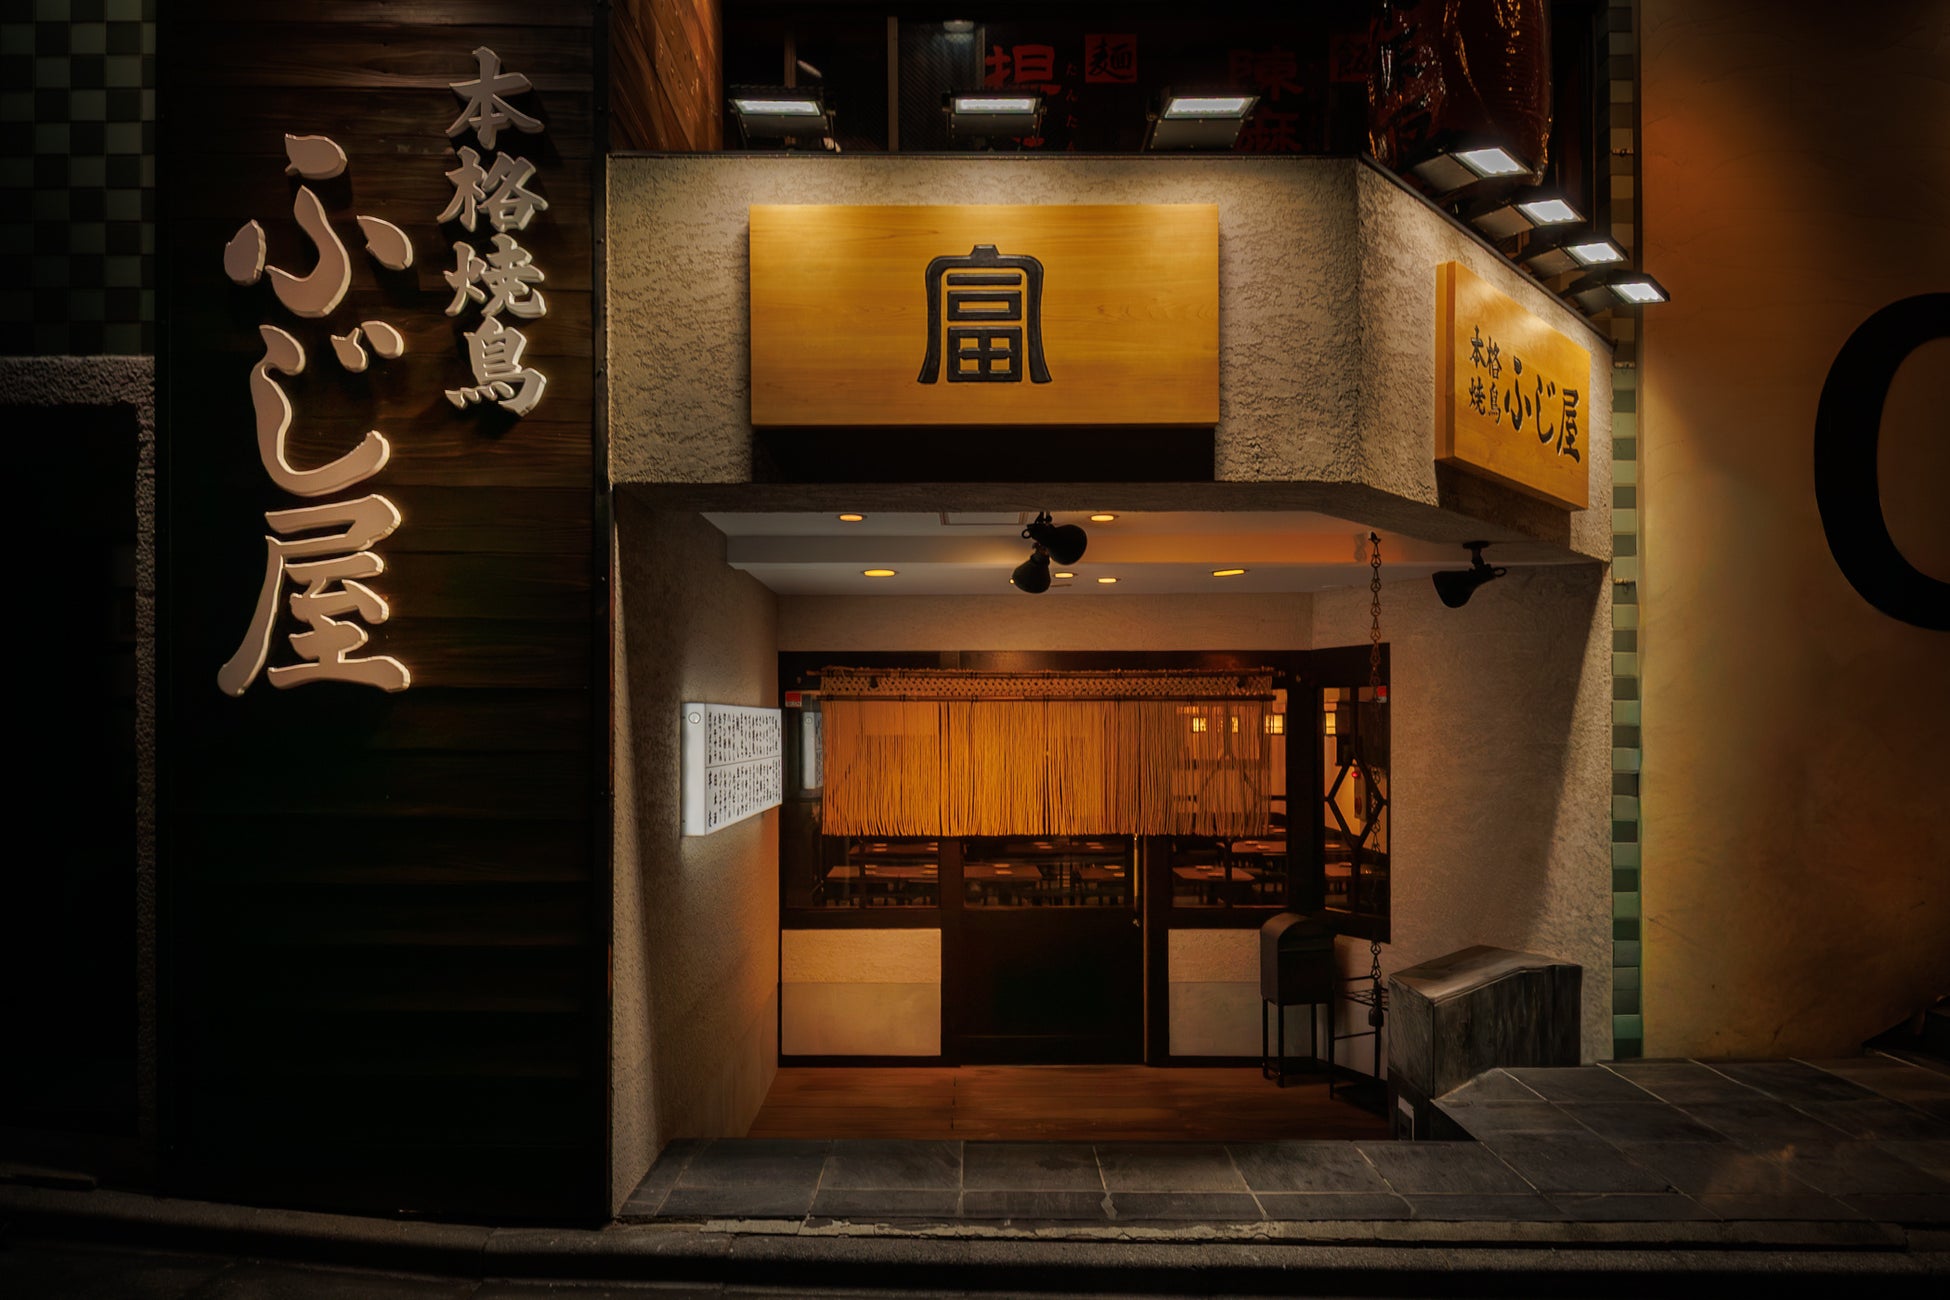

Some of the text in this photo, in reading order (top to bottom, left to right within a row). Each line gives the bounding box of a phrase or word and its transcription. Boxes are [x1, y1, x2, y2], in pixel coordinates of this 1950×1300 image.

[437, 46, 548, 417] 本格焼鳥
[917, 244, 1053, 384] 富
[1469, 325, 1502, 380] 本格
[217, 133, 414, 697] ふじ屋
[1469, 376, 1501, 425] 焼鳥
[1504, 355, 1581, 464] ふじ屋
